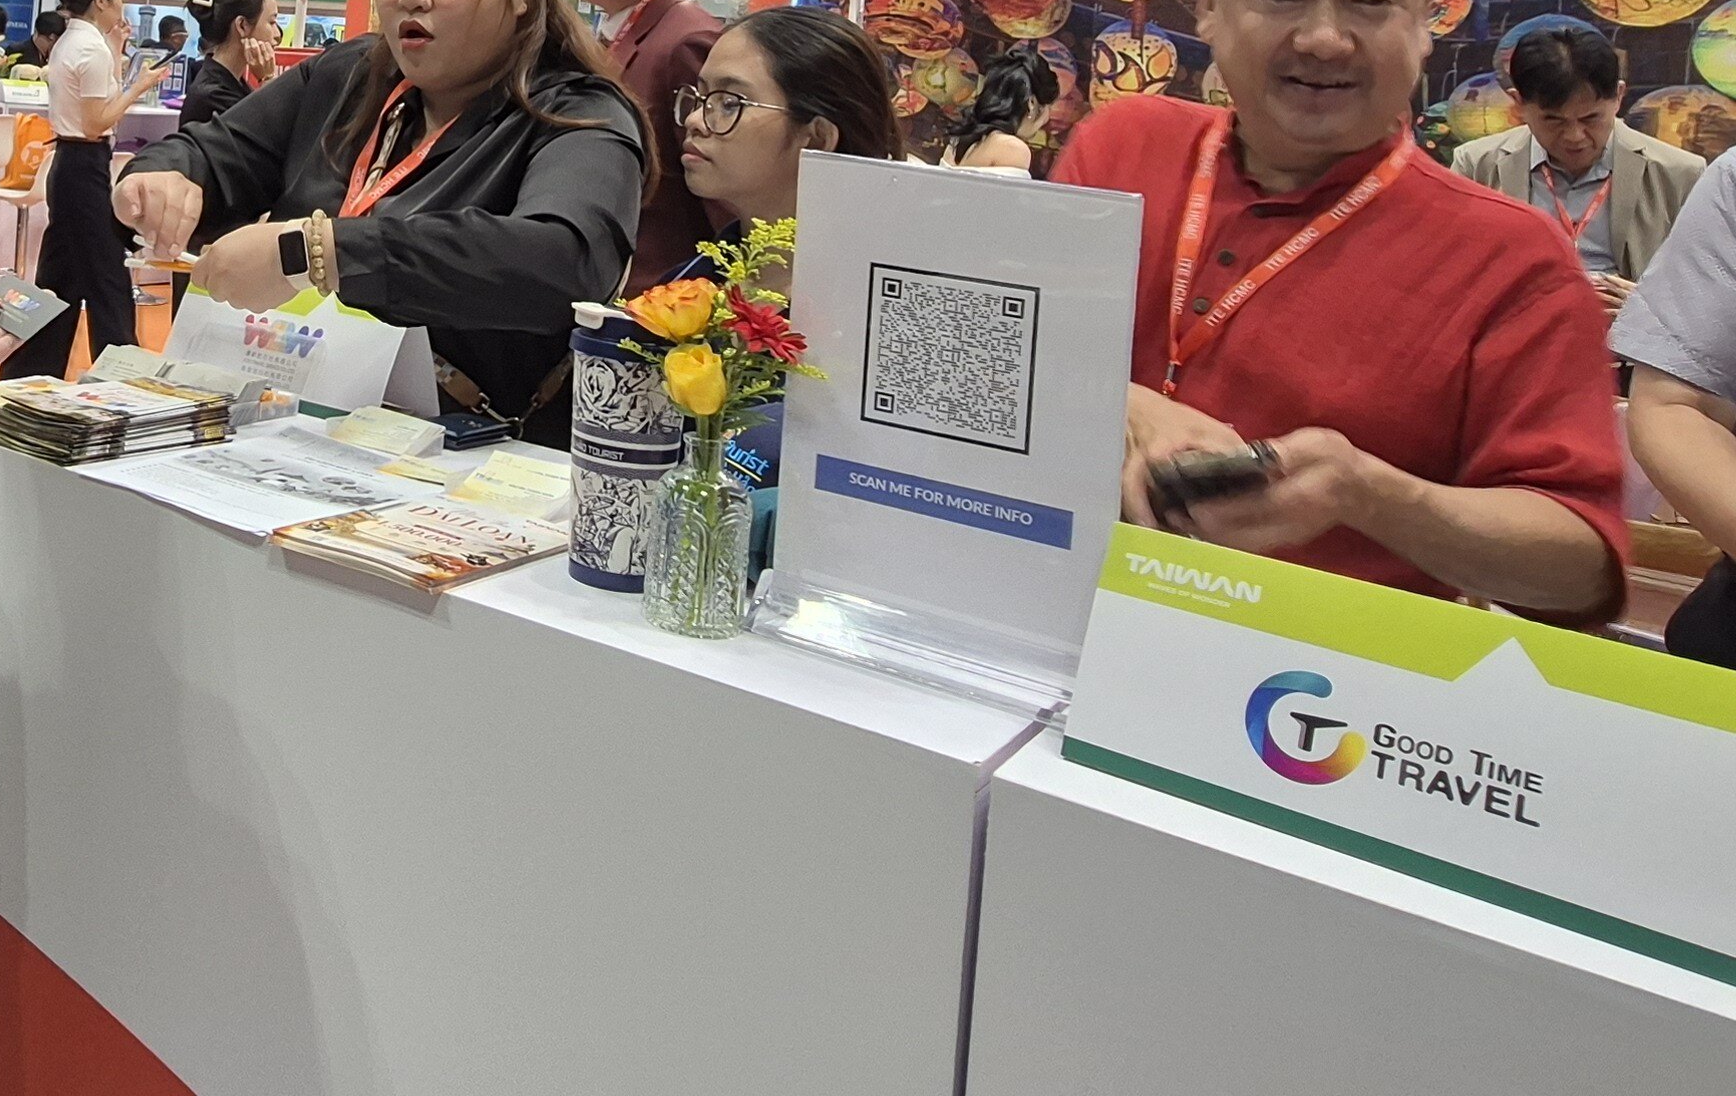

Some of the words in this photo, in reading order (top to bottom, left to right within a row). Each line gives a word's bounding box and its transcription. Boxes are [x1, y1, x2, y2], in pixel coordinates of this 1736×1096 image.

[1329, 201, 1351, 221] ITE
[1347, 175, 1383, 207] HCMC
[1264, 252, 1287, 272] ITE
[1284, 227, 1320, 256] HCMC
[1205, 308, 1225, 328] ITE
[1221, 279, 1258, 312] HCMC
[588, 445, 625, 461] TOURIST
[849, 472, 888, 492] SCAN
[889, 481, 912, 498] ME
[914, 487, 944, 506] FOR
[946, 494, 992, 517] MORE
[994, 506, 1034, 526] INFO
[1125, 552, 1263, 604] TAIWAN
[1370, 749, 1541, 828] TRAVEL
